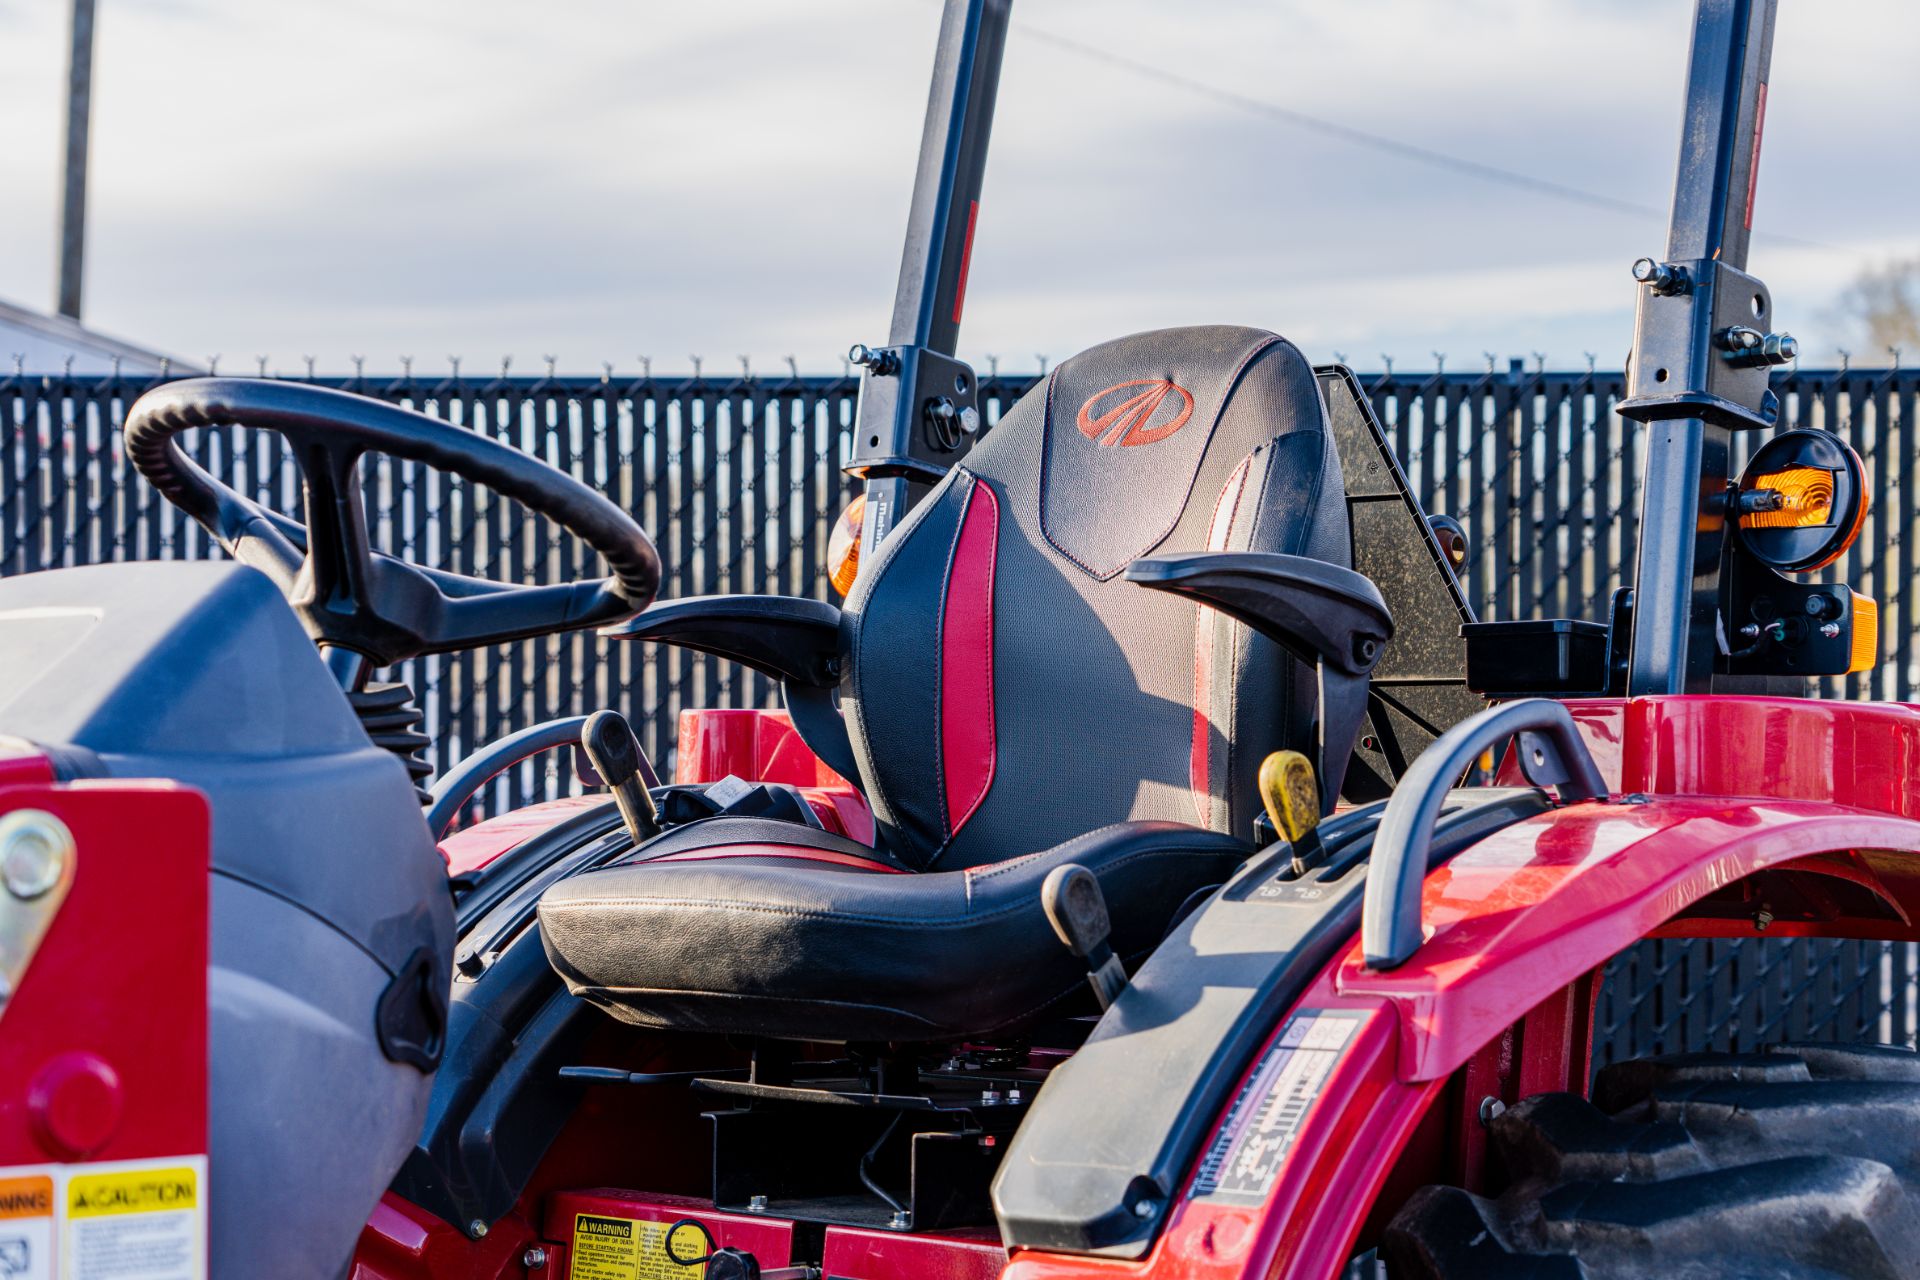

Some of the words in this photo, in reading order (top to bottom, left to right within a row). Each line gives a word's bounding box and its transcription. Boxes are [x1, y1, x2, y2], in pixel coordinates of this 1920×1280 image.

[875, 502, 887, 548] mahin
[95, 1182, 192, 1207] CAUTION
[588, 1222, 630, 1236] WARNING
